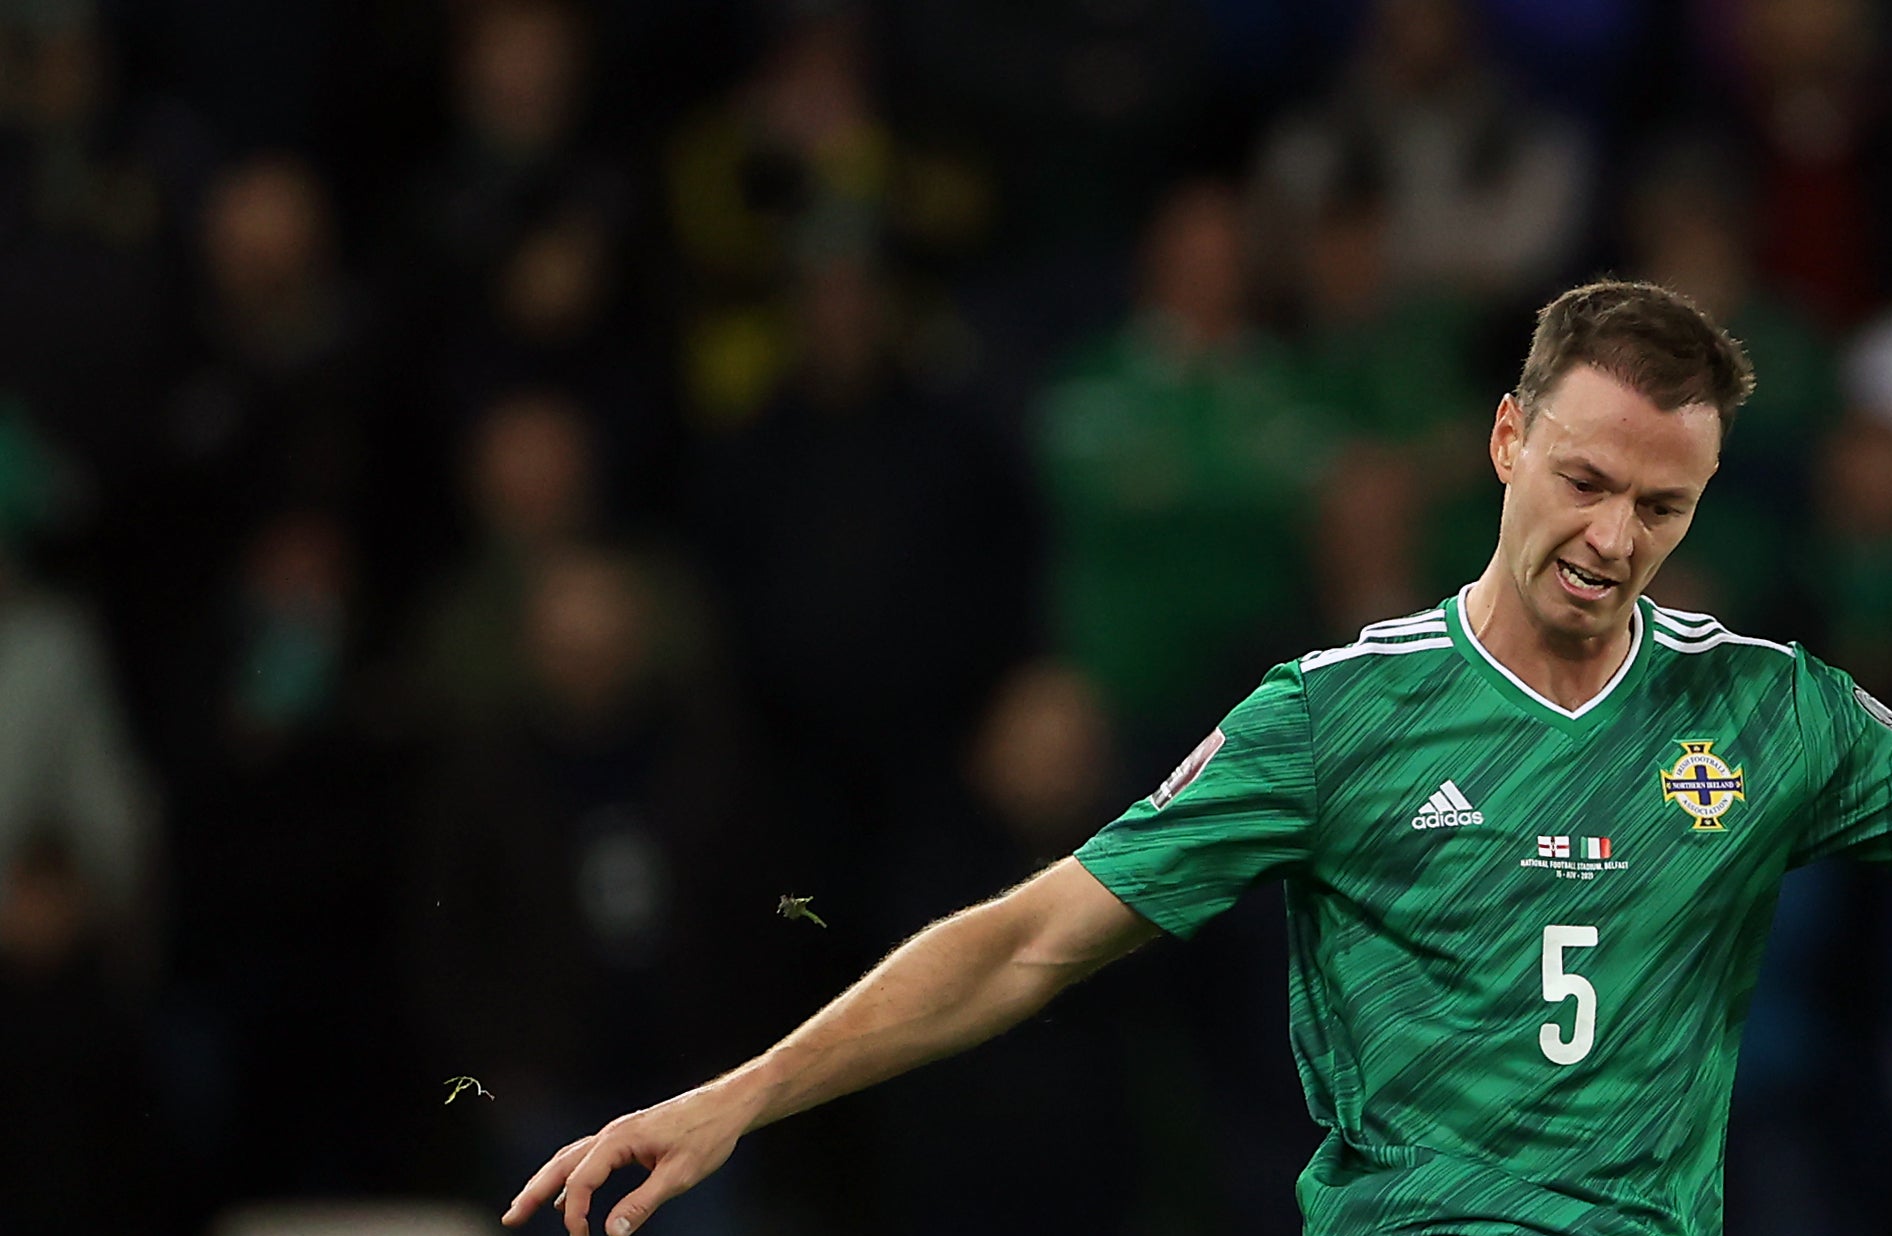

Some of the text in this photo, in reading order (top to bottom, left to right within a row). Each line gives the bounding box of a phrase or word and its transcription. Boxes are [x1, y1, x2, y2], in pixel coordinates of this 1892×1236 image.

[1672, 781, 1735, 789] NORTHERN IRELAND
[1683, 799, 1728, 815] ASSOCIATION
[1411, 811, 1484, 830] adidas
[1520, 859, 1548, 868] NATIONAL
[1550, 861, 1576, 870] FOOTBALL
[1604, 861, 1629, 871] BELFAST
[1540, 925, 1598, 1065] 5
